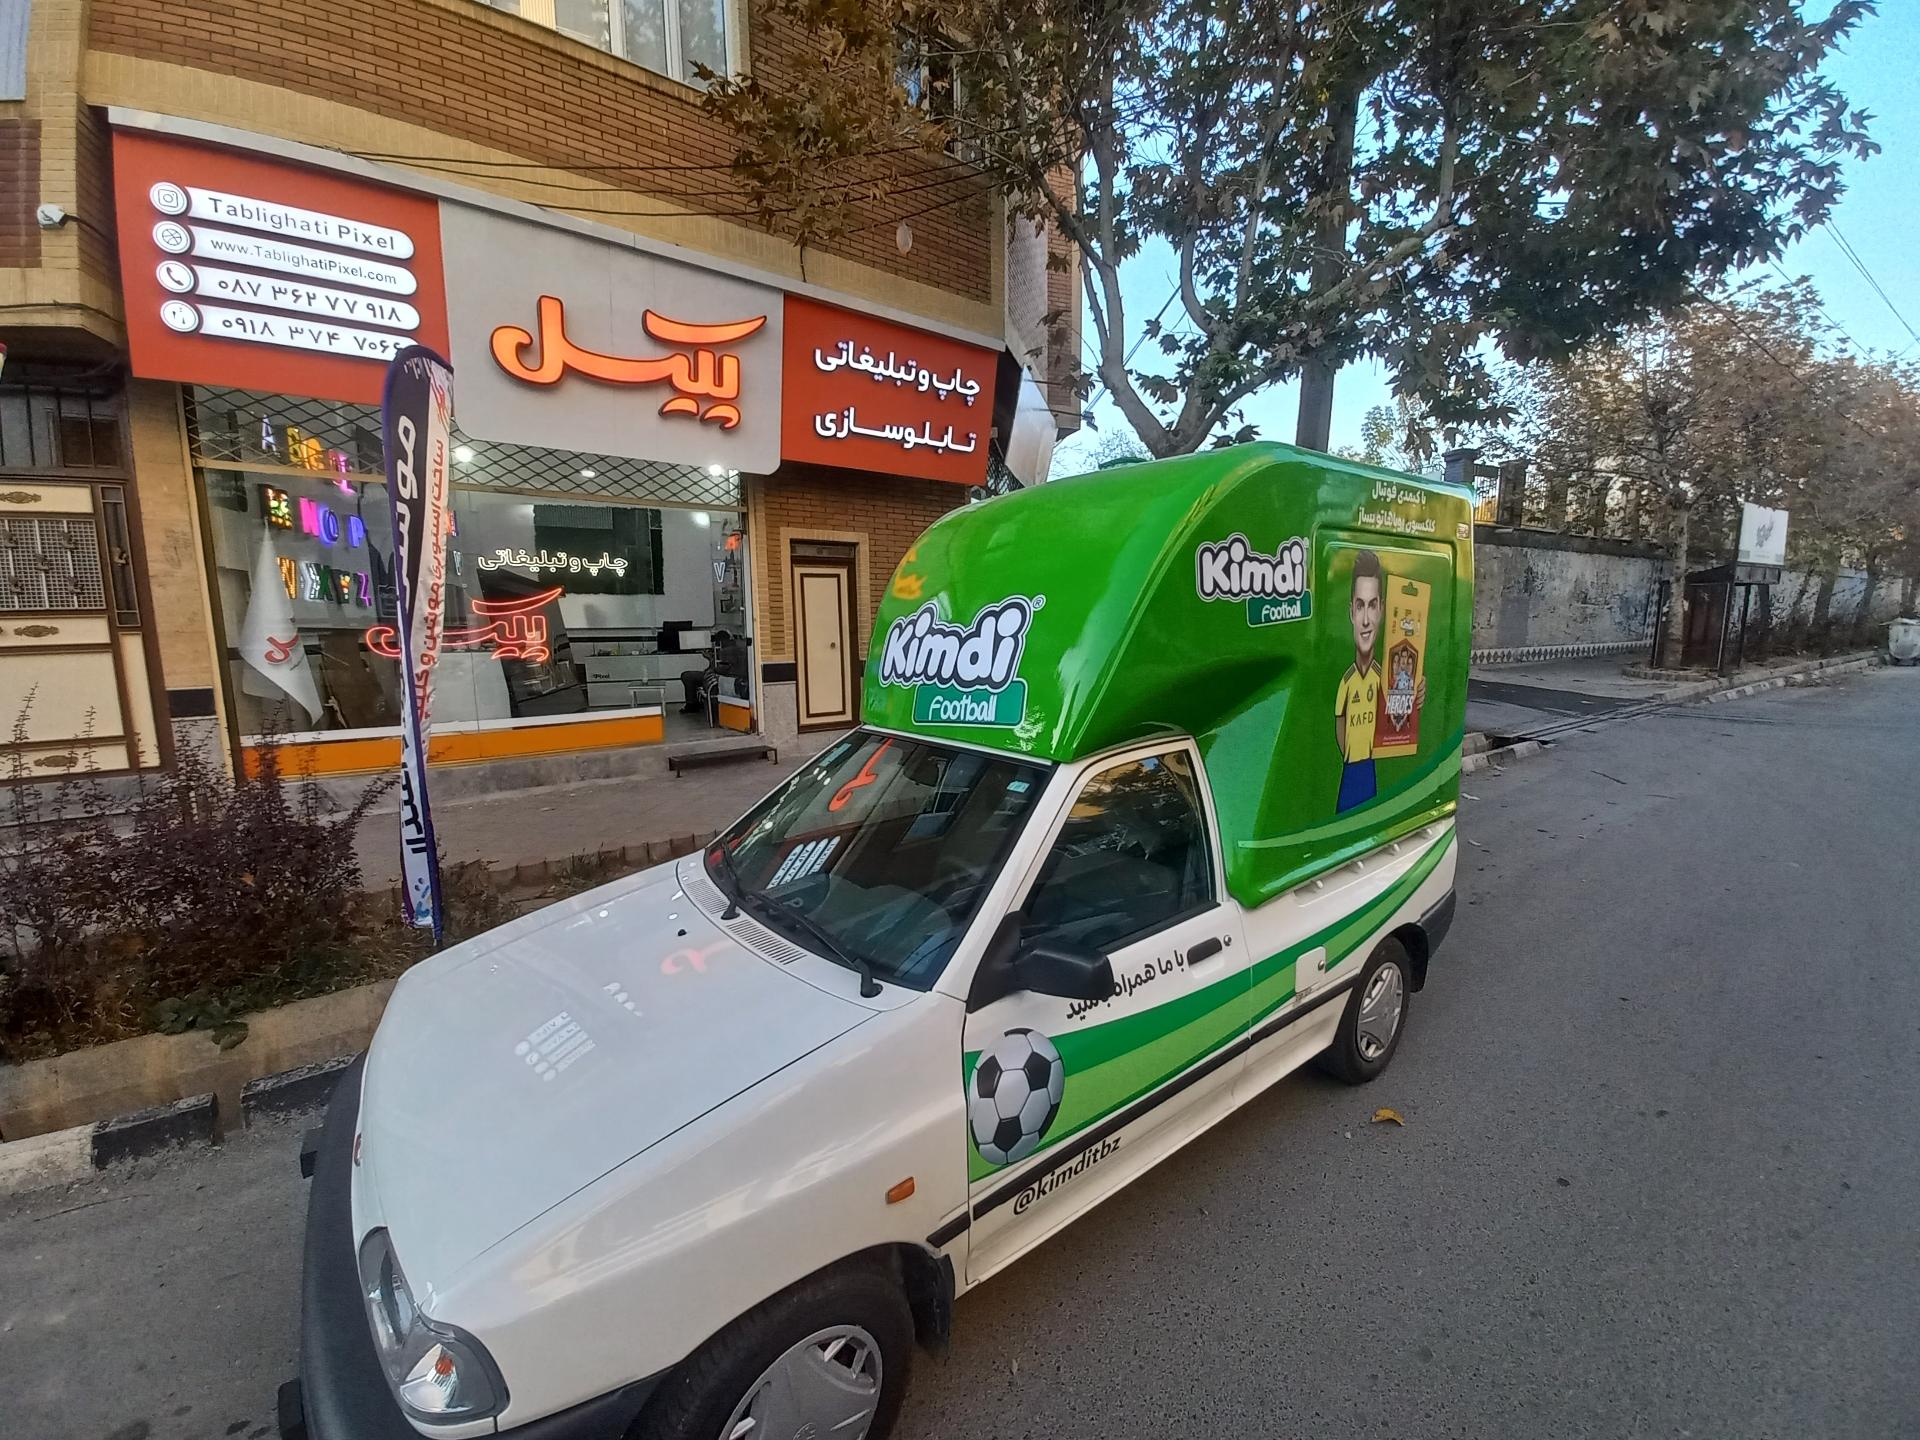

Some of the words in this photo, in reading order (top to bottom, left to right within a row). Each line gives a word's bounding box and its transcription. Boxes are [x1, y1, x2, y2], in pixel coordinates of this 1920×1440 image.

[208, 197, 329, 236] Tablighati
[338, 224, 395, 250] Pixel
[210, 239, 397, 285] www.TablighatiPixel.com
[814, 340, 917, 387] تبلیغاتی
[932, 368, 981, 407] چاپ
[478, 549, 568, 572] تبلیغاتی
[582, 552, 628, 577] چاپ
[1200, 537, 1304, 598] Kimdi
[1261, 600, 1302, 623] Football
[882, 599, 1029, 689] Kimdi
[928, 694, 998, 722] Football
[1349, 711, 1374, 727] KAFD
[1157, 957, 1173, 975] ما
[1173, 949, 1185, 973] با
[1013, 1136, 1122, 1215] @kimditbz
